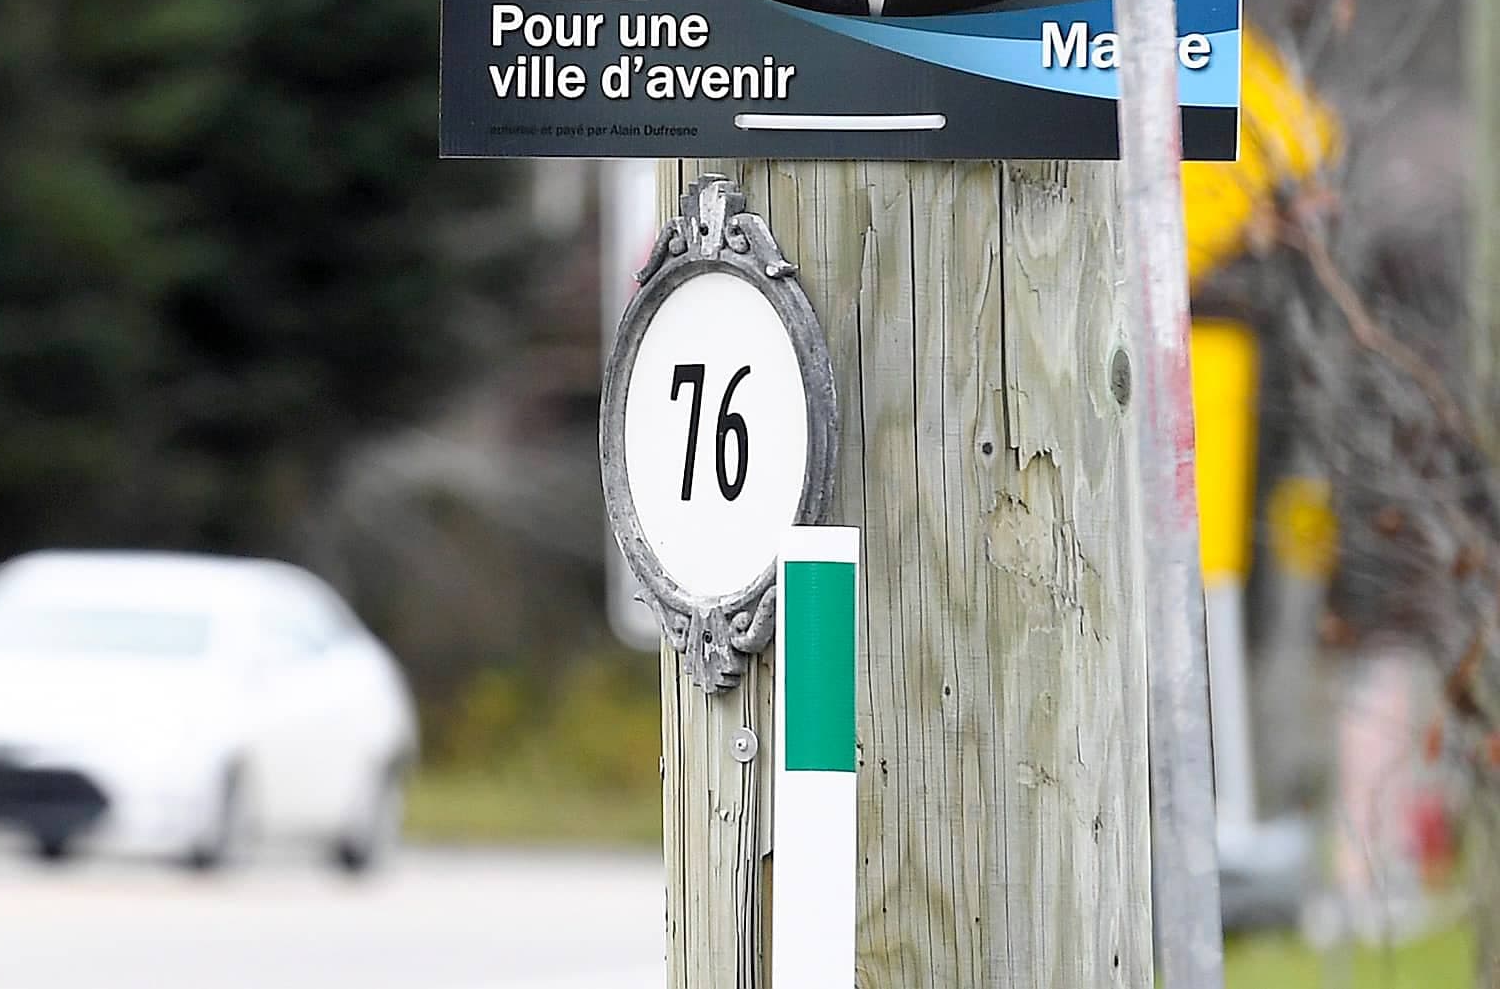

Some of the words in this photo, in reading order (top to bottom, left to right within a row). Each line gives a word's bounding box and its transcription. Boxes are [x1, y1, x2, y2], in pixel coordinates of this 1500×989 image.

[492, 4, 604, 48] Pour
[620, 12, 709, 48] une
[1042, 22, 1212, 69] Mae
[489, 55, 587, 98] ville
[609, 124, 641, 137] Alain
[644, 124, 699, 137] Dufresne
[670, 363, 751, 501] 76
